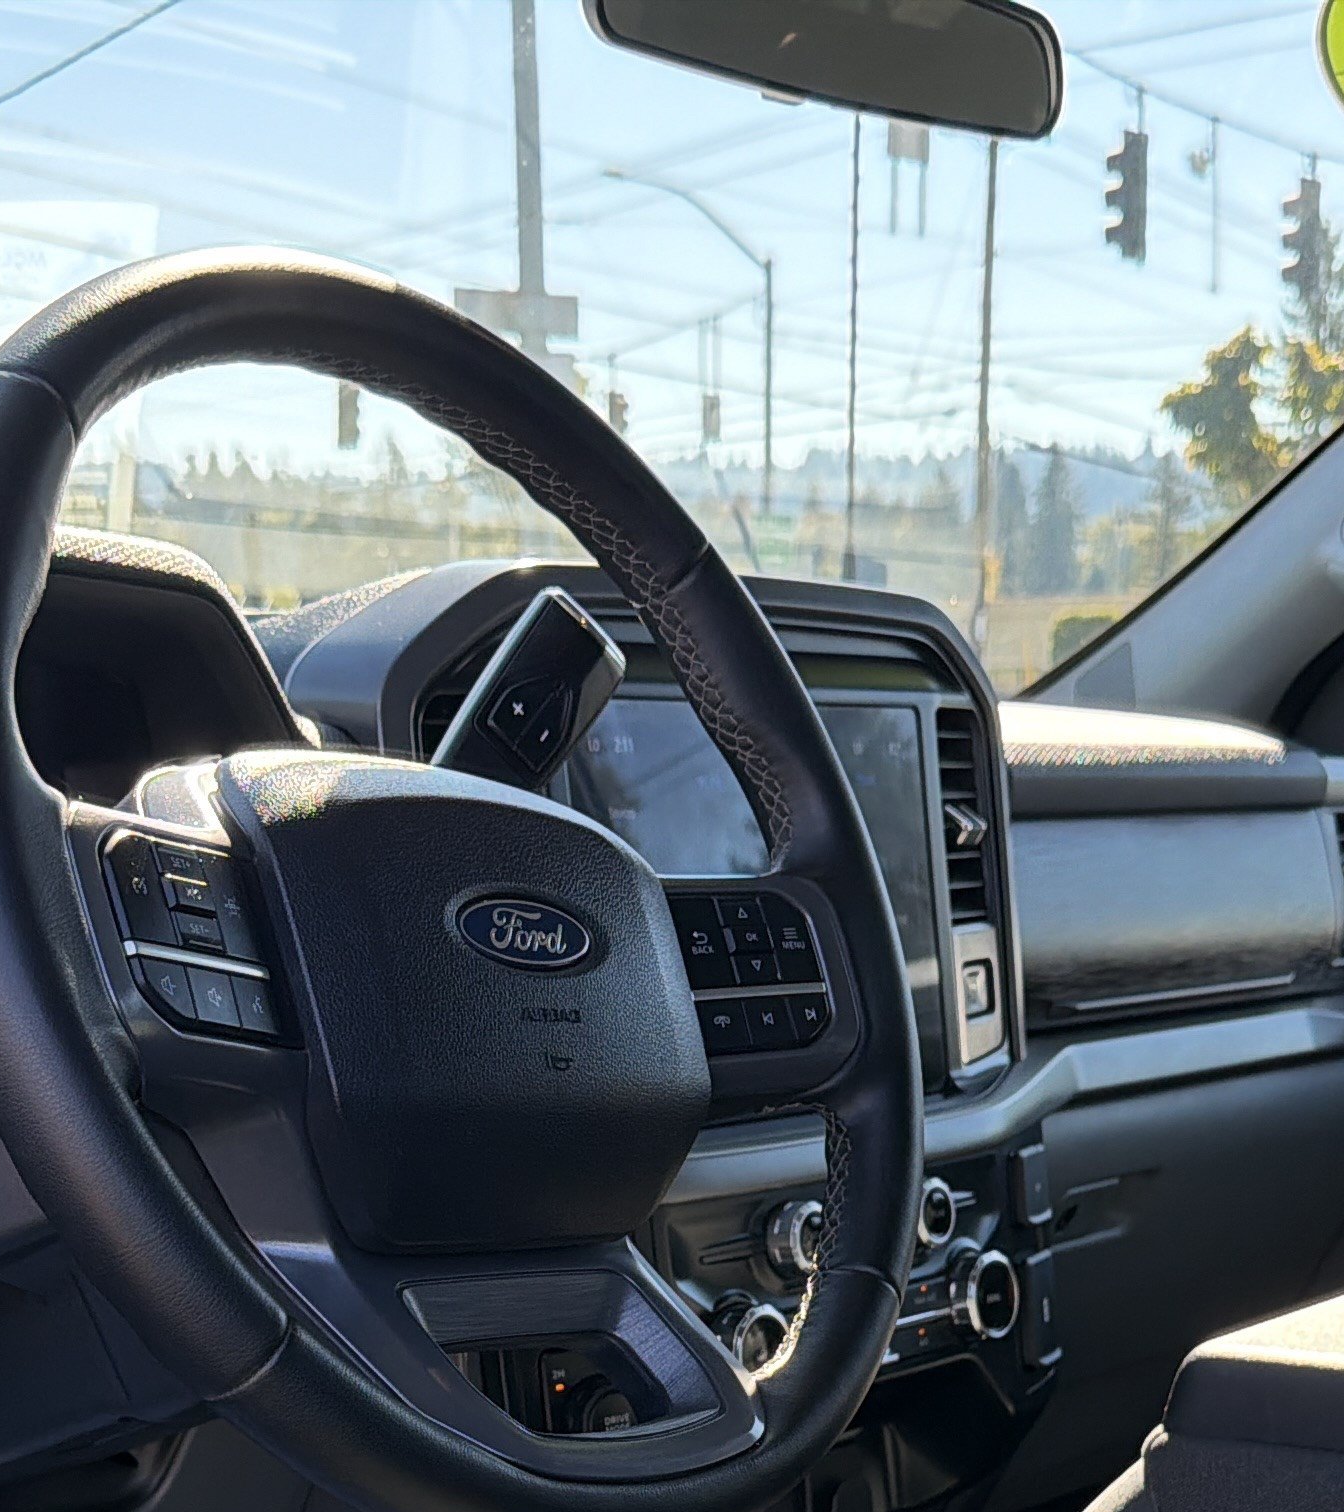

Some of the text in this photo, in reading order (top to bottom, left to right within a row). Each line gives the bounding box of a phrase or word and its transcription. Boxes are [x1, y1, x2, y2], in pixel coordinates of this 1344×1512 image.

[490, 906, 568, 957] Ford
[746, 933, 759, 943] OK
[691, 945, 715, 956] BACK
[781, 940, 806, 951] MENU
